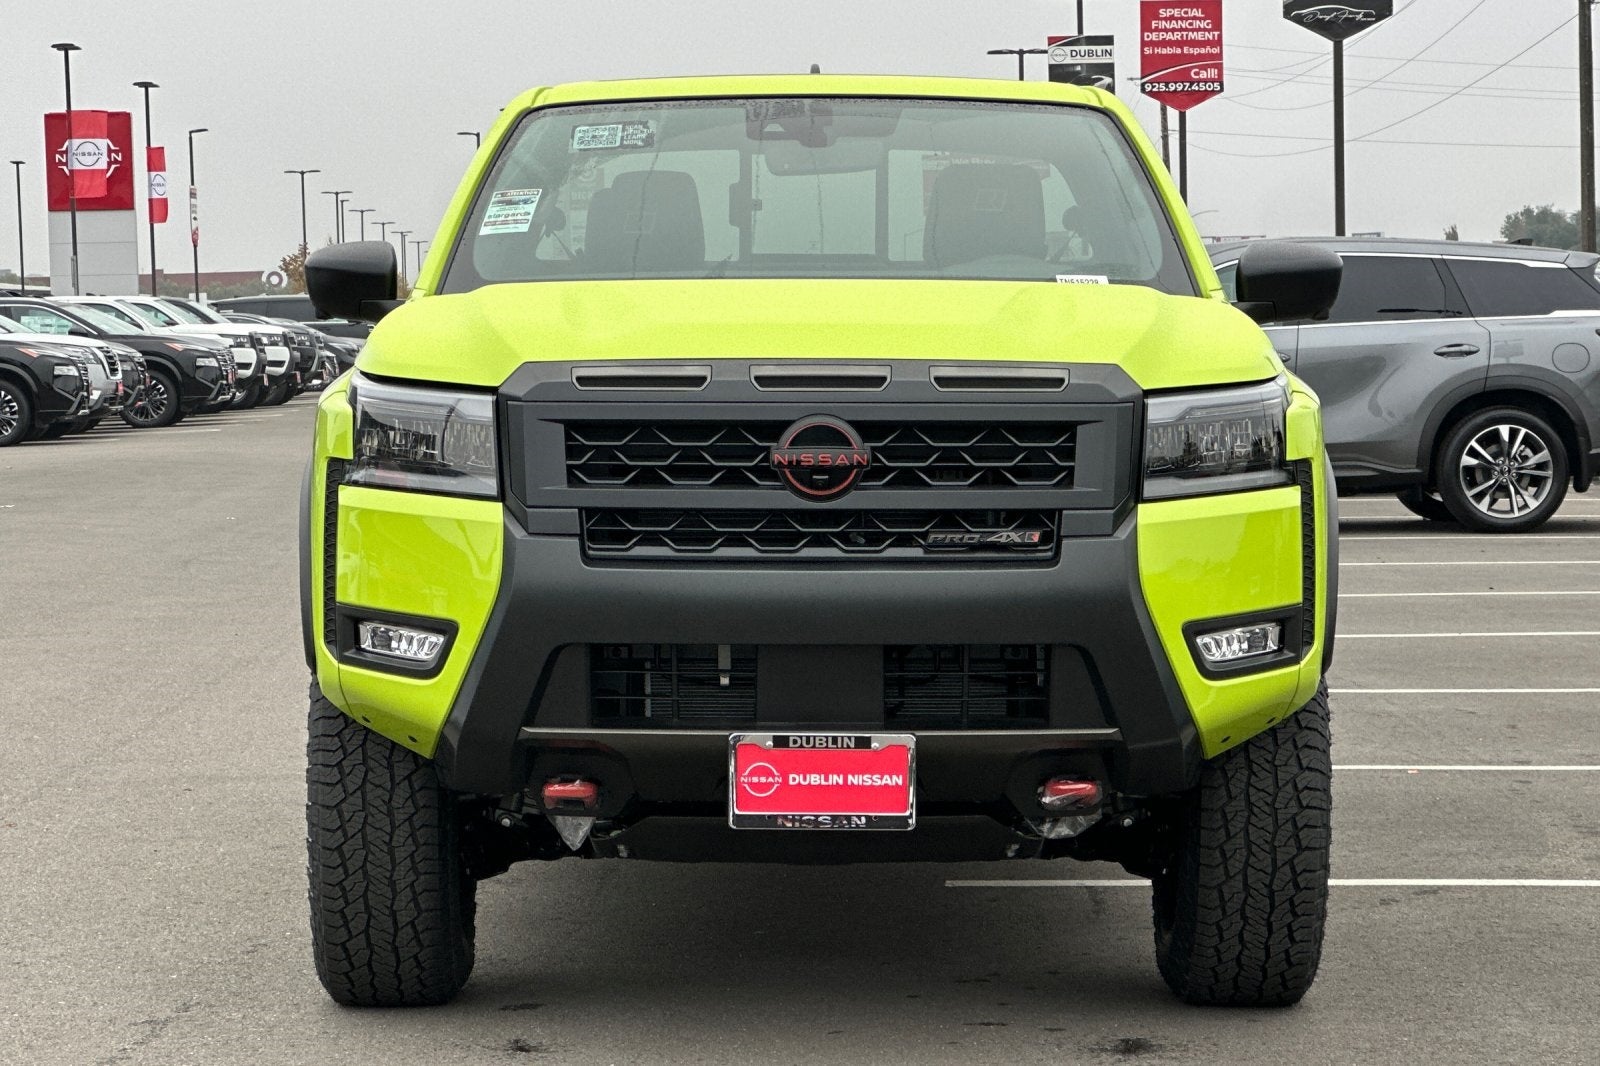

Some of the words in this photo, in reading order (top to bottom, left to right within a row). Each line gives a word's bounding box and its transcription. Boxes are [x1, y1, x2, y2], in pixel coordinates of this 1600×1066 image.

[1159, 8, 1205, 17] SPECIAL
[1151, 20, 1212, 29] FINANCING
[1144, 31, 1220, 41] DEPARTMENT
[1070, 49, 1113, 58] DUBLIN
[1143, 46, 1153, 55] Si
[1154, 46, 1182, 54] Habla
[1183, 45, 1220, 55] Español
[1190, 68, 1219, 79] Call!
[1144, 82, 1221, 92] 925.997.4505
[774, 453, 868, 466] NISSAN
[928, 531, 1024, 544] PRO-4X
[788, 736, 856, 749] DUBLIN
[788, 773, 844, 786] DUBLIN
[847, 774, 904, 786] NISSAN
[777, 815, 867, 828] NISSAN
